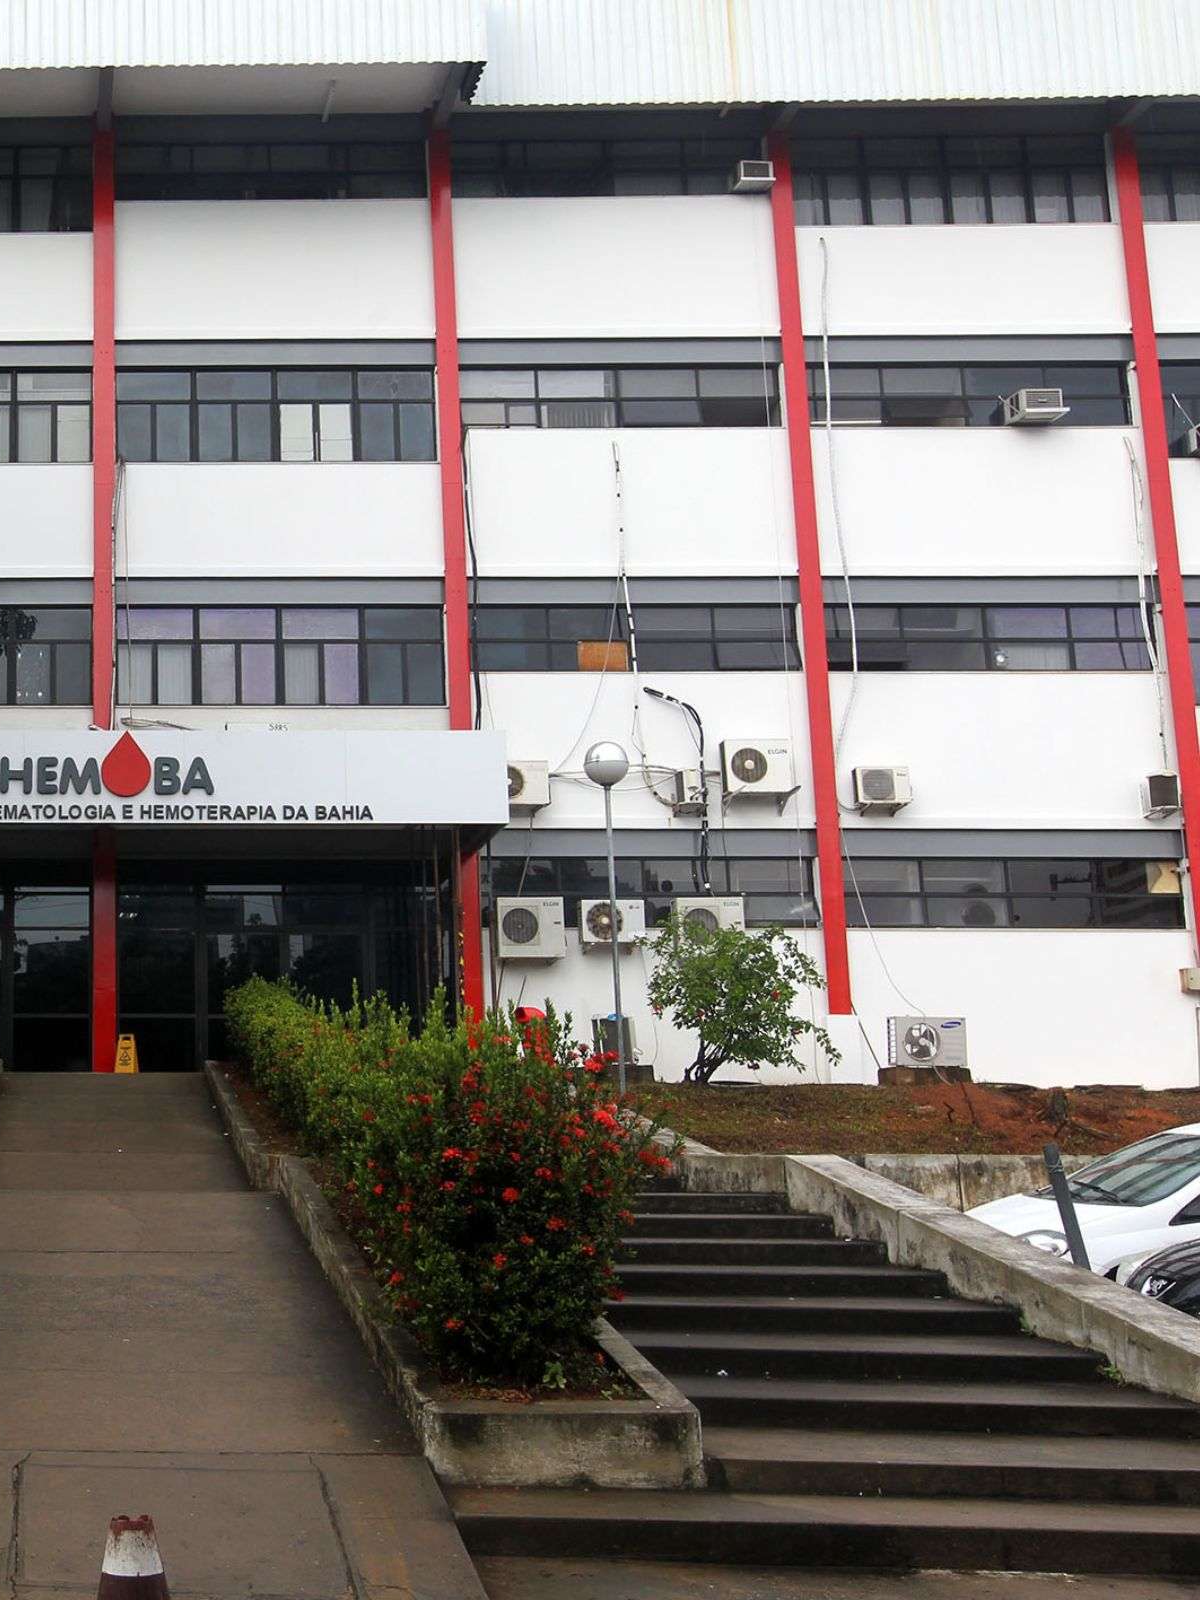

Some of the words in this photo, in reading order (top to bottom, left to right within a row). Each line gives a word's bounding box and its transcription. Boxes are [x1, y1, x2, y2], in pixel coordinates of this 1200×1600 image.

[122, 804, 134, 820] E
[140, 804, 277, 821] HEMOTERAPIA
[282, 804, 309, 821] DA
[315, 804, 374, 821] BAHIA
